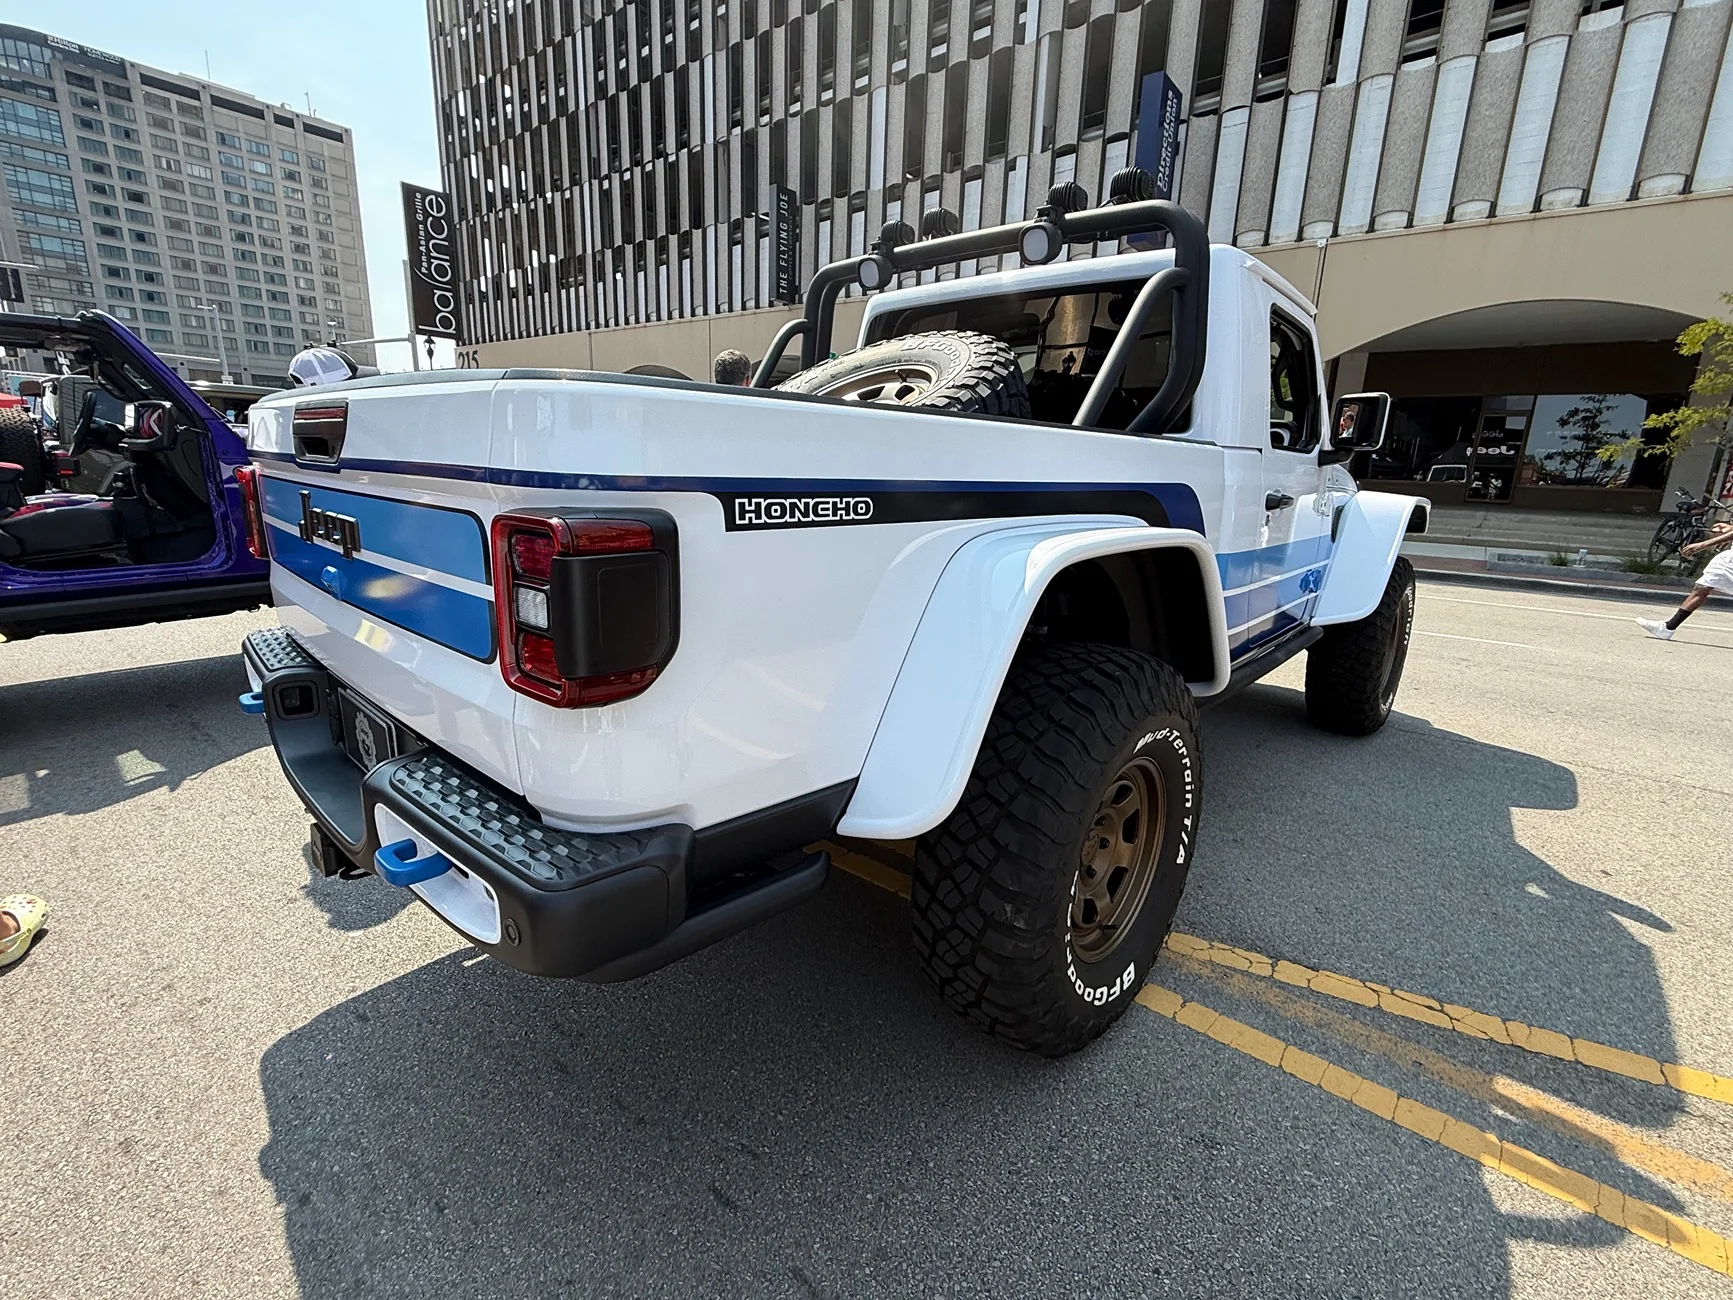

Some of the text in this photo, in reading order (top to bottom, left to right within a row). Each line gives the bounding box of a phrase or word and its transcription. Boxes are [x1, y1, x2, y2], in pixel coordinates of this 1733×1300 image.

[1157, 90, 1173, 189] Directions
[1162, 98, 1177, 192] Credit Union
[413, 194, 456, 334] balance
[415, 192, 428, 274] Pan-Asian Grille
[780, 192, 788, 294] THE FLYING JOE
[458, 350, 479, 369] 215
[298, 489, 361, 560] Jeep
[735, 497, 874, 525] HONCHO
[1132, 727, 1195, 864] Mud-Terrain T/A
